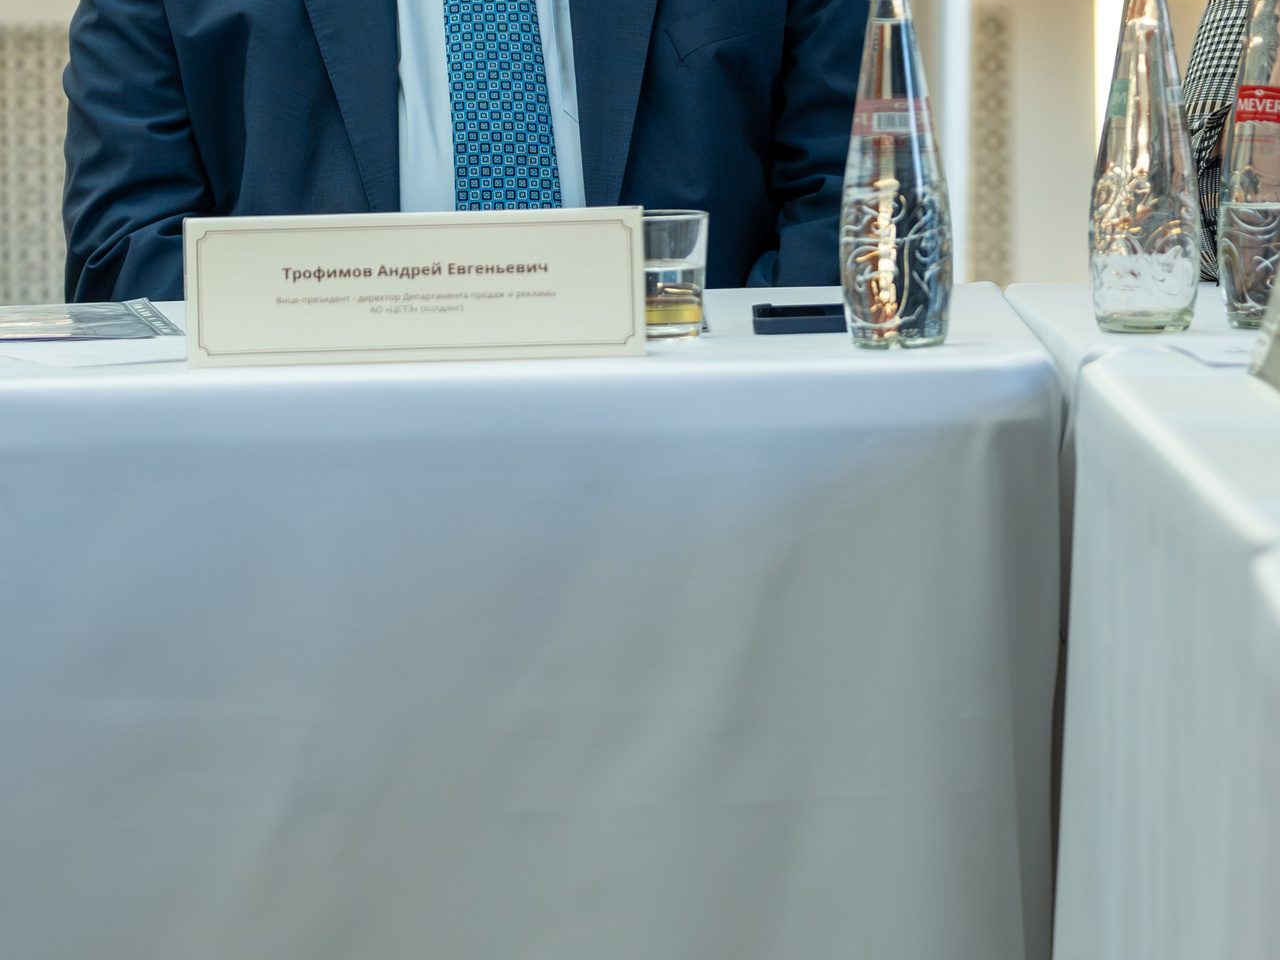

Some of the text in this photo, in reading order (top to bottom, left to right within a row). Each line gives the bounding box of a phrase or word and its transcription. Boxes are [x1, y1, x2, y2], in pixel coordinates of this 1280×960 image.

[282, 262, 549, 283] Трофимов Андрей Евгеньевич
[358, 294, 400, 304] директор
[471, 292, 505, 301] продаж
